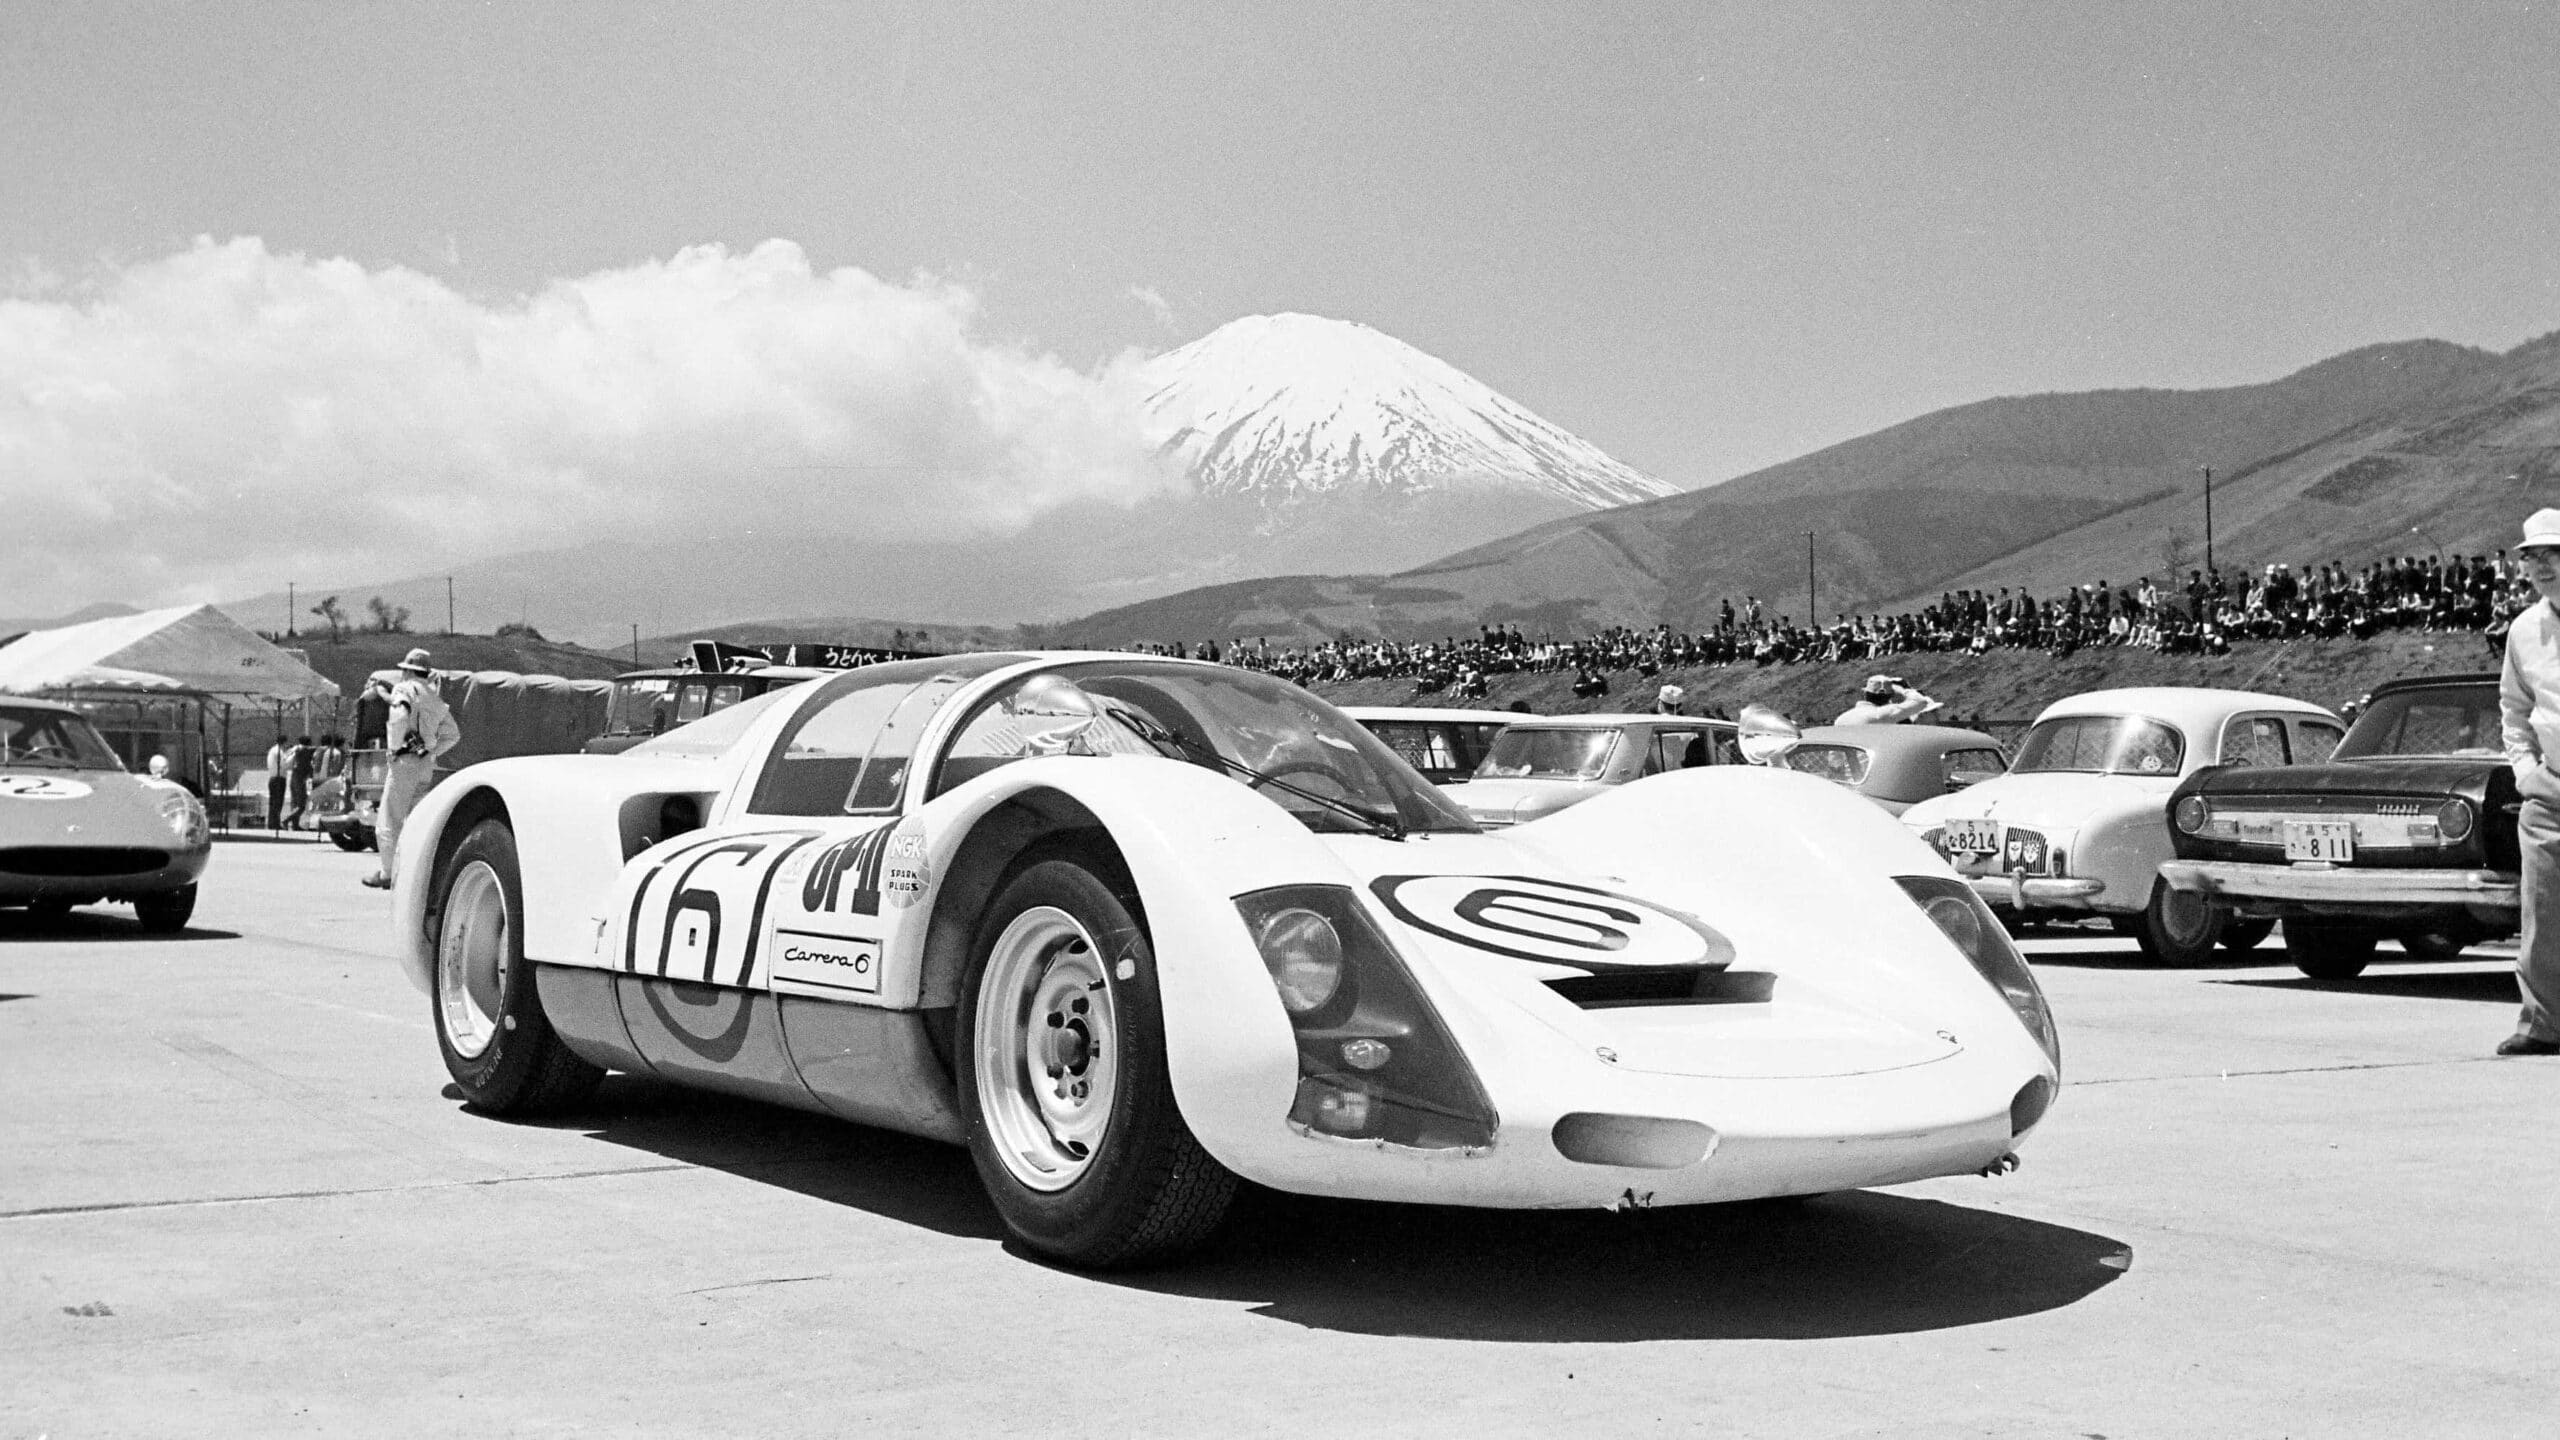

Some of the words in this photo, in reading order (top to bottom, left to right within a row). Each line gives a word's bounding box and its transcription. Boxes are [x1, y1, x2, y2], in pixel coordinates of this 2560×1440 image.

[892, 834, 924, 858] NGK
[1959, 832, 1996, 850] 8214
[890, 869, 917, 879] SPARK
[889, 881, 919, 892] PLUGS
[656, 842, 768, 1007] 6
[1453, 887, 1641, 951] 6
[784, 945, 854, 967] Carrera
[854, 952, 871, 974] 6
